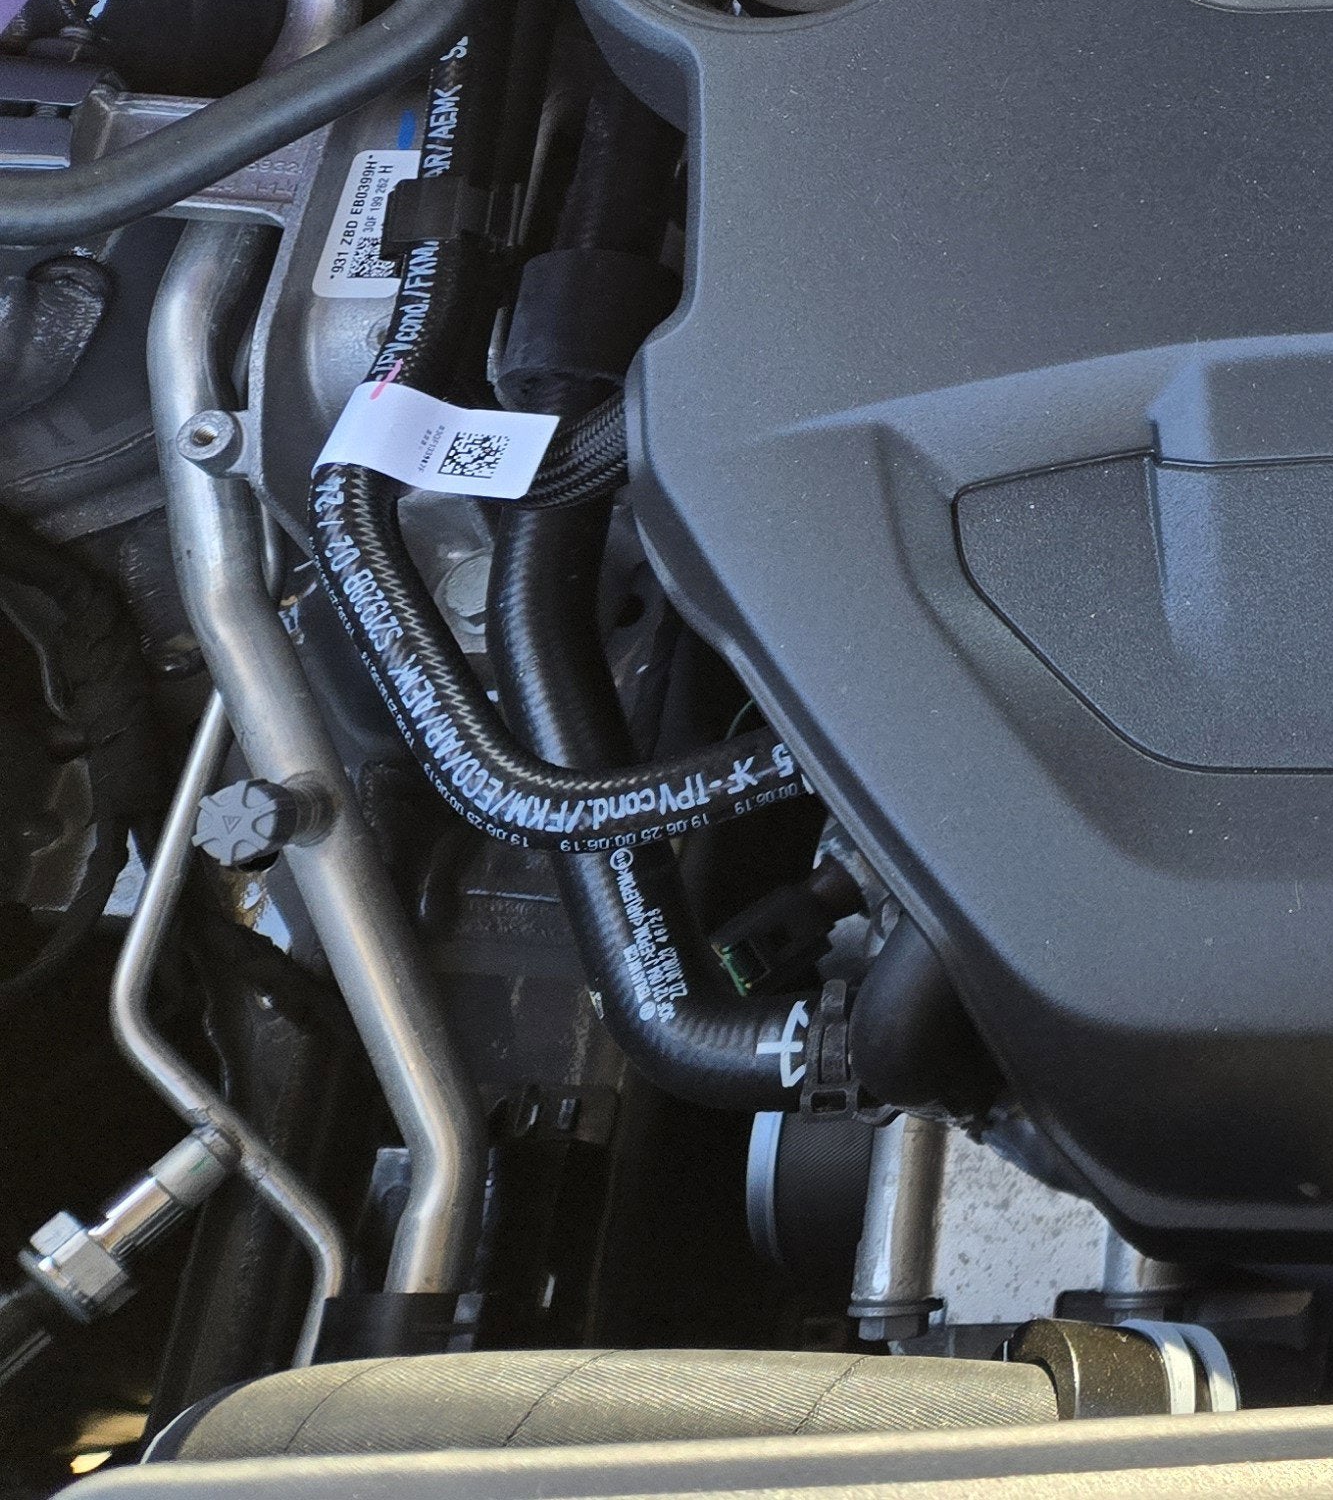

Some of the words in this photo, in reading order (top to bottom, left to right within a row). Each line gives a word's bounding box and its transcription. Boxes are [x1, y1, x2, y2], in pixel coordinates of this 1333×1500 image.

[379, 162, 394, 176] H
[375, 176, 390, 195] 262
[369, 195, 384, 213] 199
[340, 218, 359, 247] ZBD
[362, 214, 378, 235] 3QF
